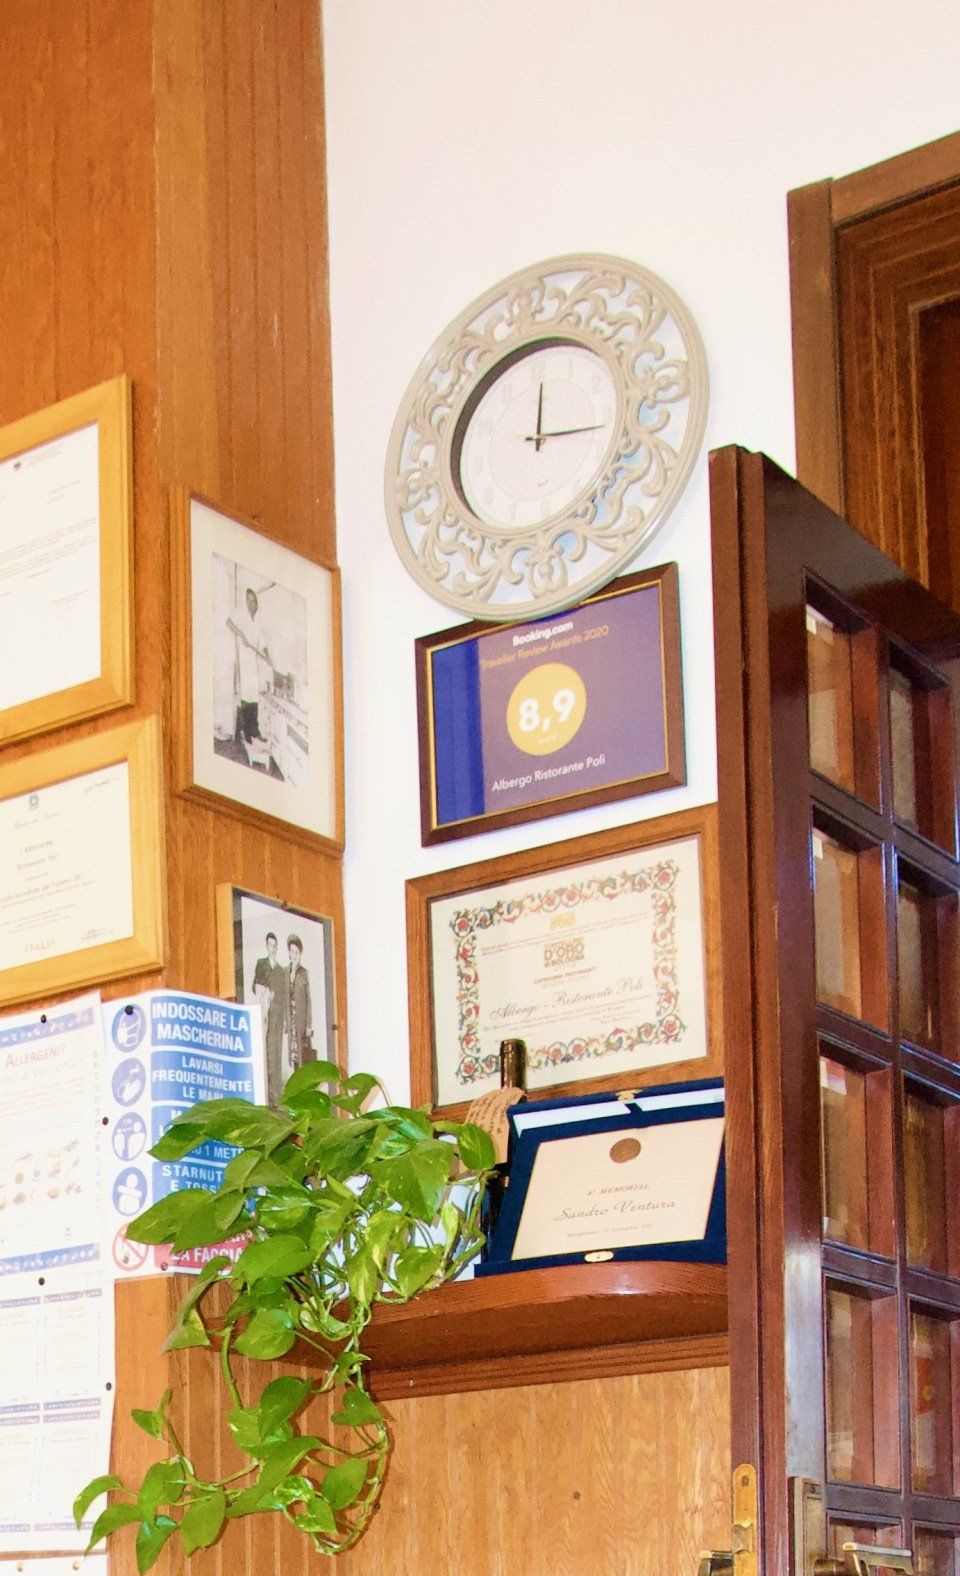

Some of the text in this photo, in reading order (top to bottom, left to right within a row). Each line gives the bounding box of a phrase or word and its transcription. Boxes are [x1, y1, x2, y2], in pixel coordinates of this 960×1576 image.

[512, 621, 574, 646] Booking.com
[519, 687, 576, 733] 8,9
[491, 753, 606, 792] Albergo Ristorante Poli
[152, 1002, 249, 1032] INDOSSARE LA
[157, 1023, 245, 1052] MASCHERINA
[182, 1056, 224, 1075] LAVARSI
[152, 1069, 252, 1092] FREQUENTEMENTE
[182, 1086, 195, 1099] LE
[162, 1164, 223, 1182] STARNUT
[170, 1179, 180, 1191] E
[552, 1200, 675, 1222] Sandro Ventura
